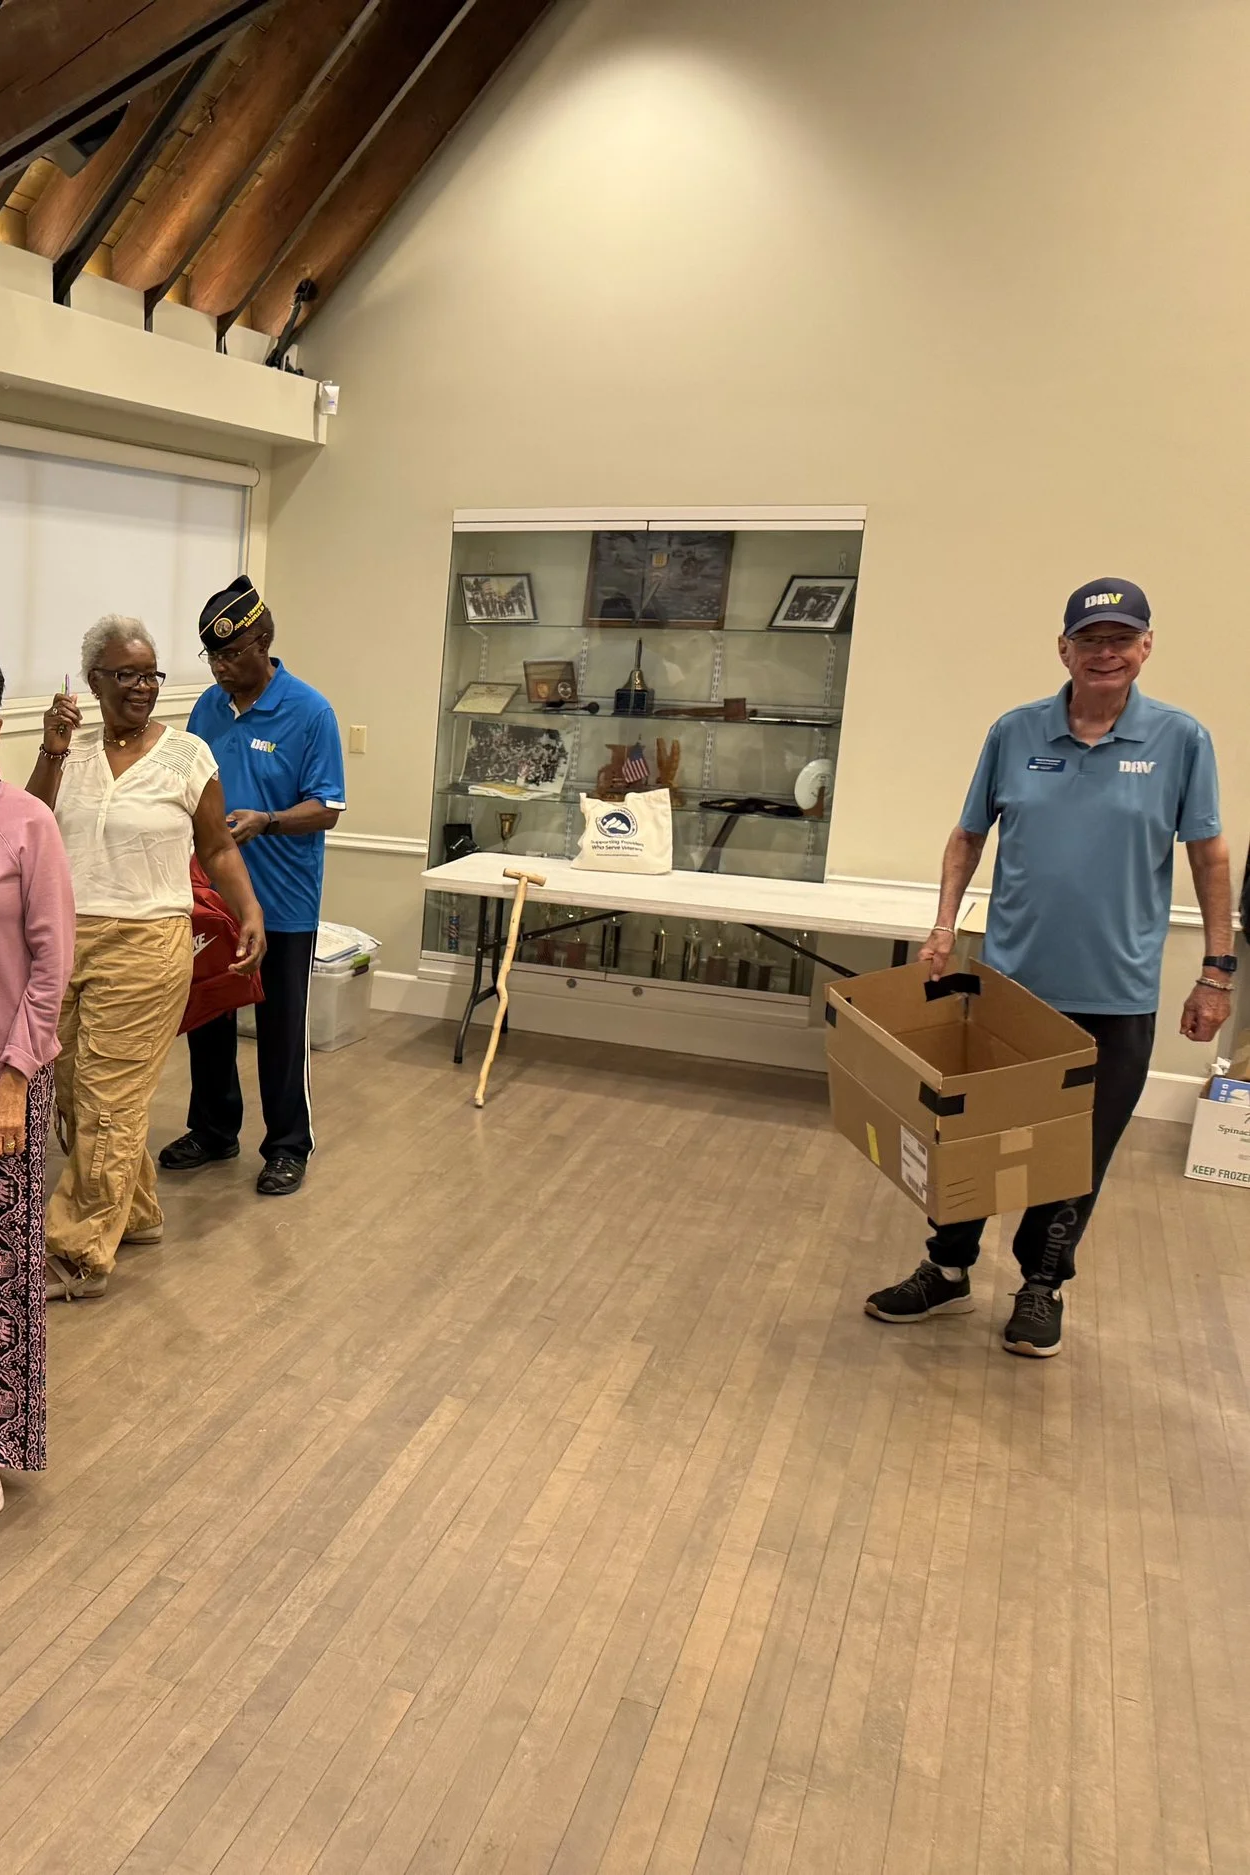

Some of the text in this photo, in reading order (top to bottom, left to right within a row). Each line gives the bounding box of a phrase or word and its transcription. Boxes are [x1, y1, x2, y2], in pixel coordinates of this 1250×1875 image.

[1084, 593, 1123, 608] DAV
[250, 738, 276, 753] DAV
[1118, 760, 1156, 774] DAV
[192, 932, 206, 951] KE
[1217, 1124, 1250, 1137] Spinac
[1192, 1164, 1216, 1176] KEEP
